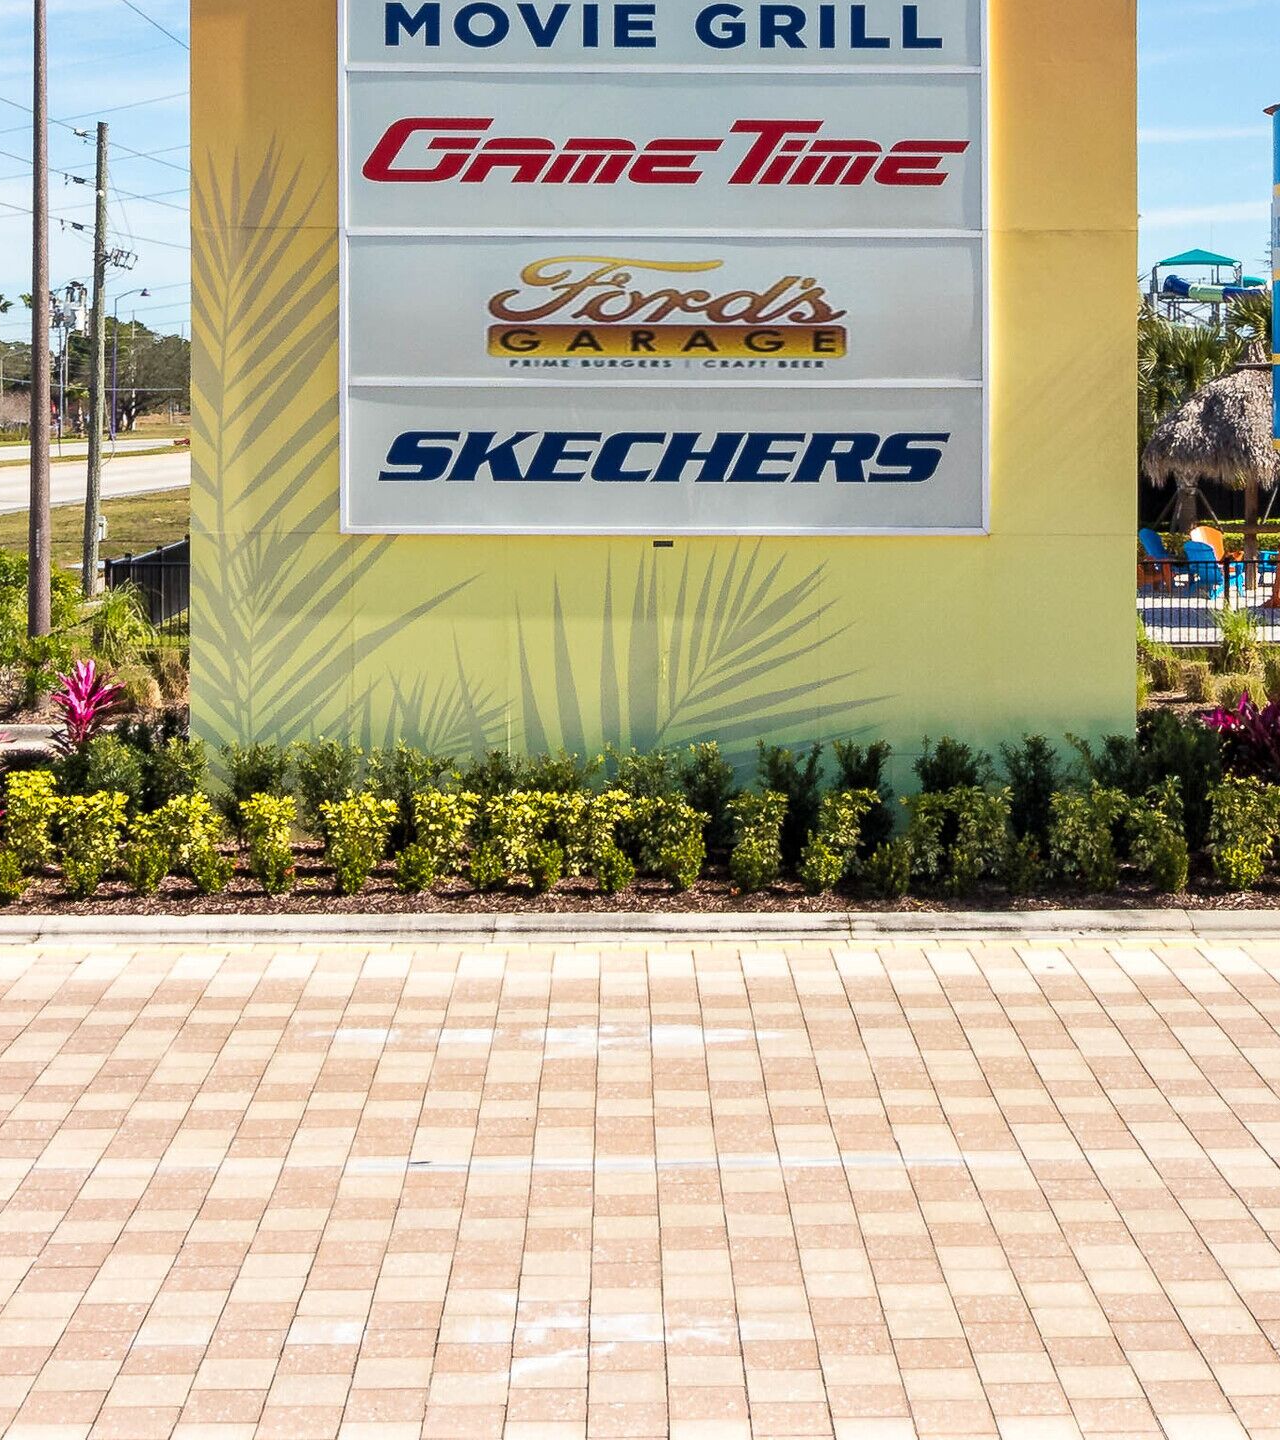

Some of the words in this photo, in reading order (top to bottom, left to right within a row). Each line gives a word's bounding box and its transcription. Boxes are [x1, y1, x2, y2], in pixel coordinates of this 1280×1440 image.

[384, 2, 657, 49] MOVIE
[694, 3, 944, 50] GRILL
[487, 255, 848, 324] Ford's
[499, 329, 837, 354] GARAGE
[509, 359, 570, 369] PRIME
[581, 359, 673, 369] BURGERS
[703, 359, 767, 369] CRAFT
[778, 359, 825, 369] BEER
[378, 430, 949, 483] SKECHERS
